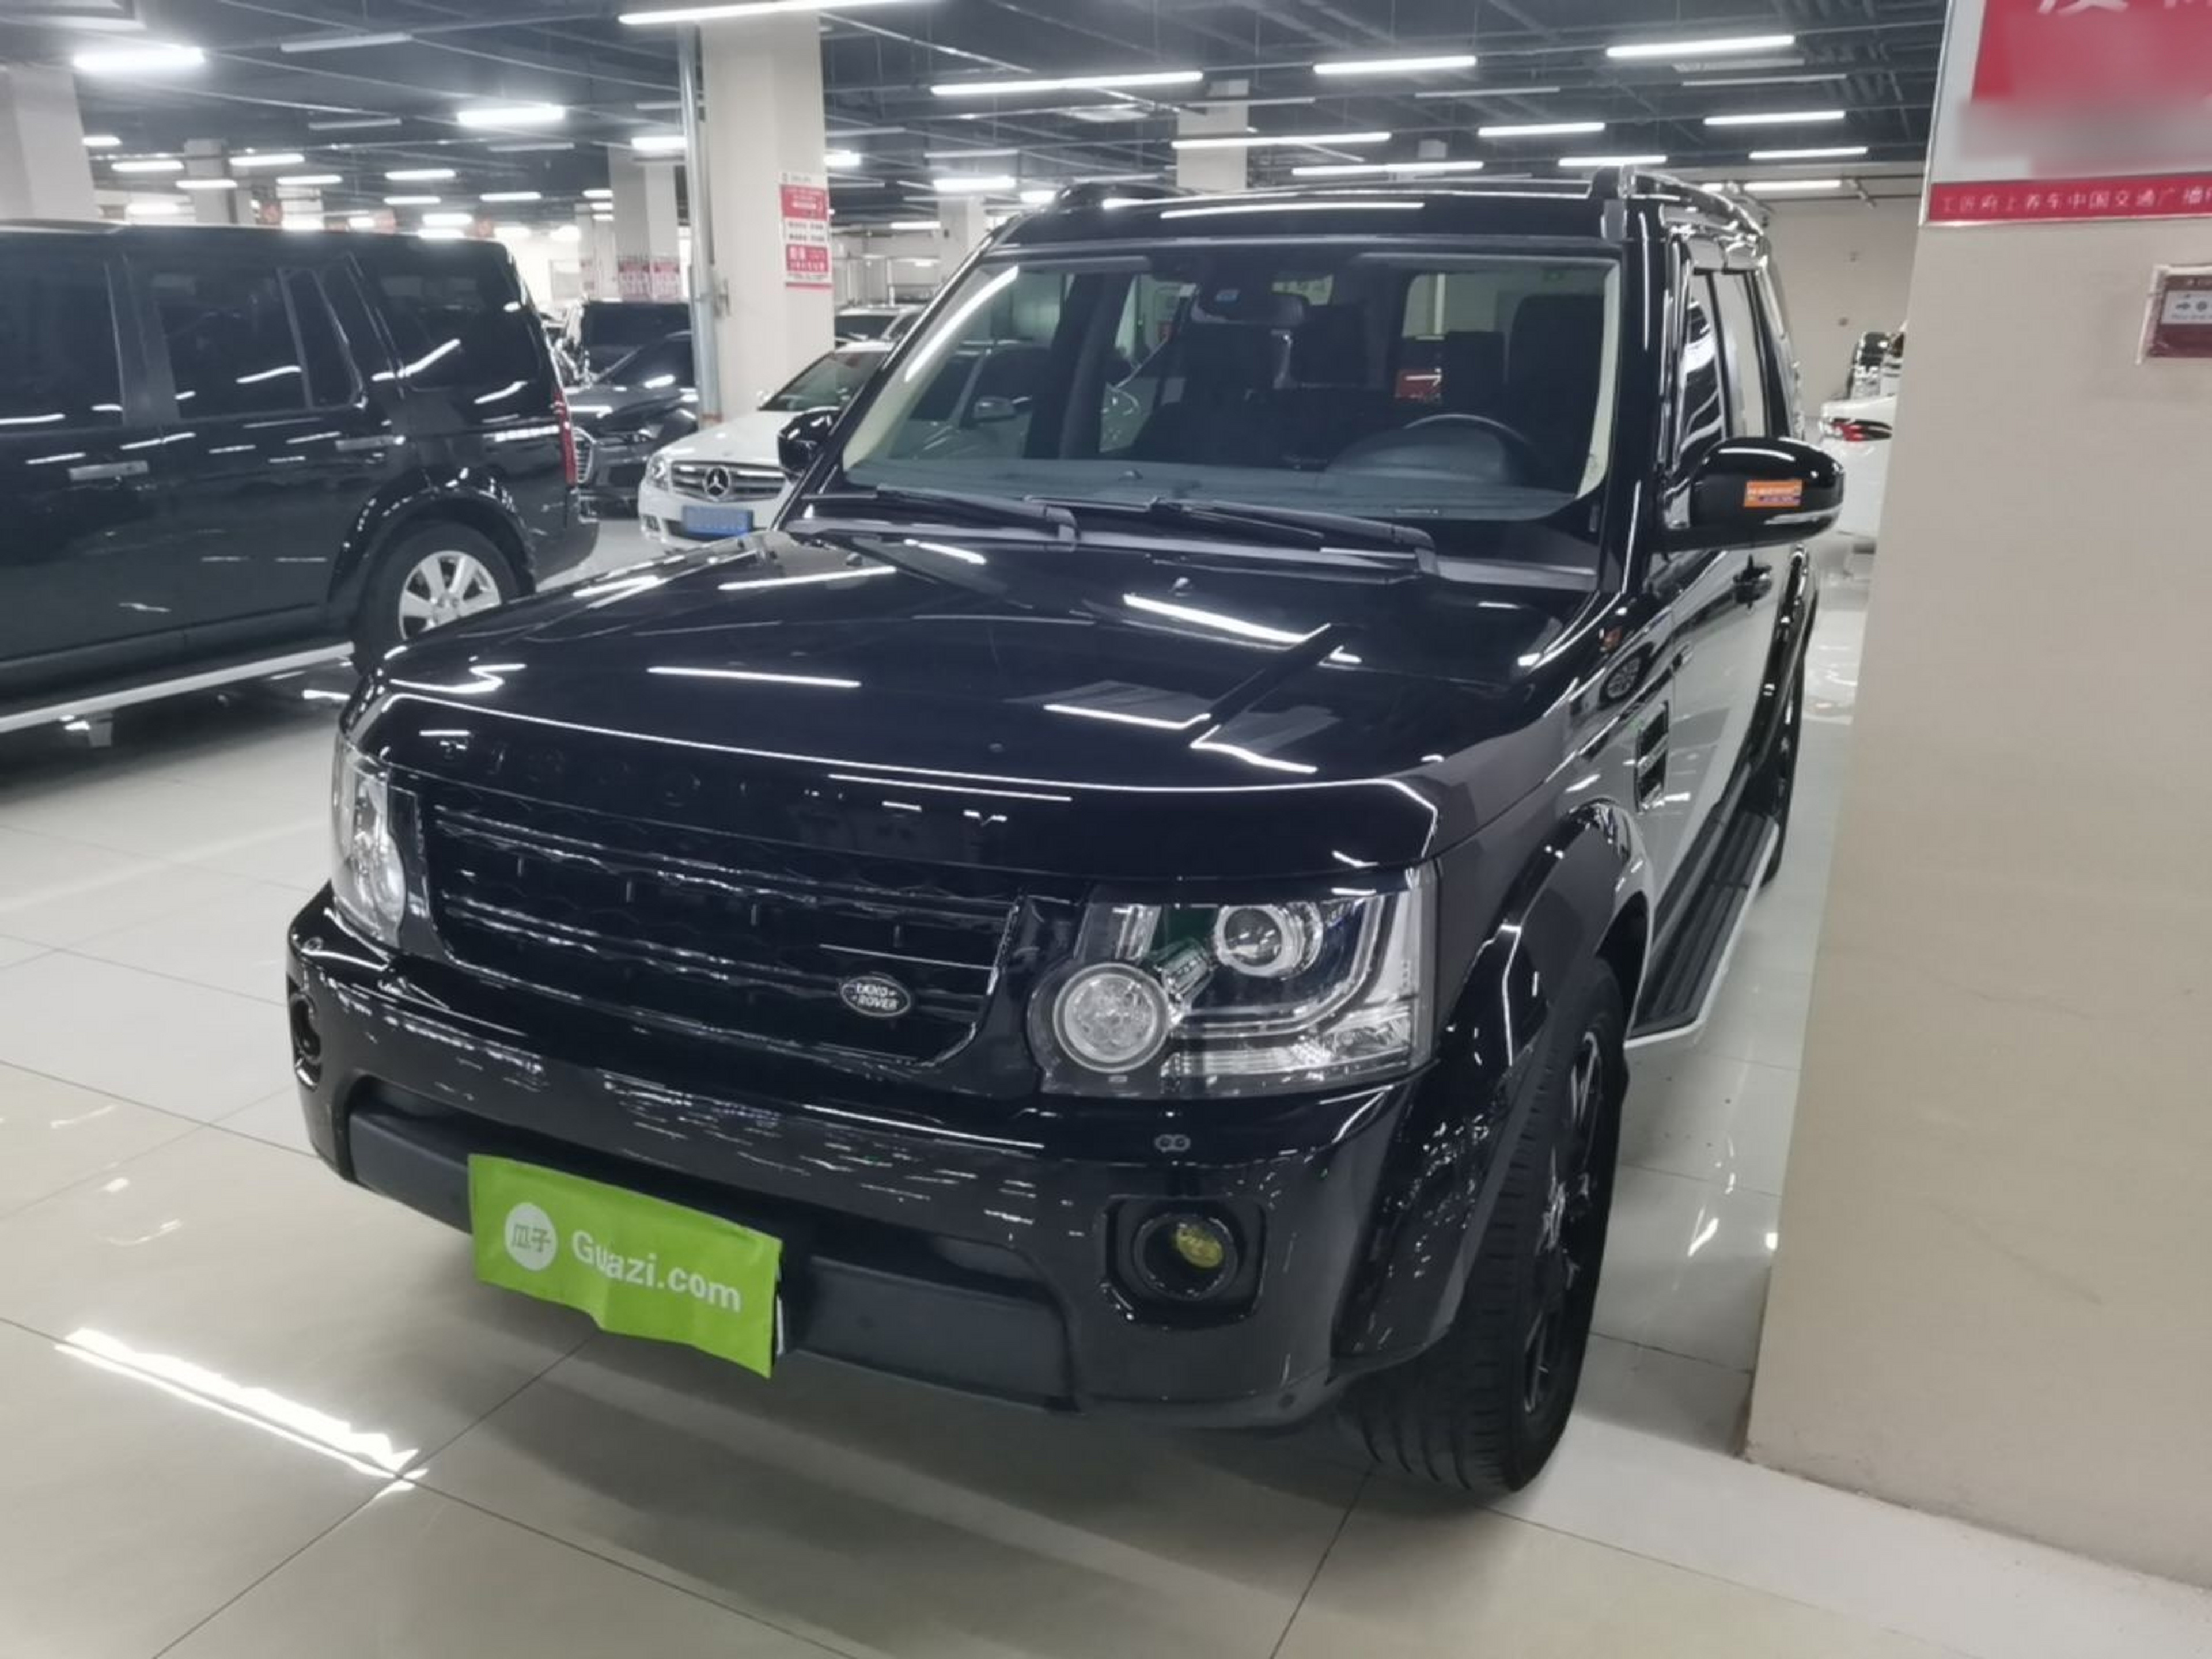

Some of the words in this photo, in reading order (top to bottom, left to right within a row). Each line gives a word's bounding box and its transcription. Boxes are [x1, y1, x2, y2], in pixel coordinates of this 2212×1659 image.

[856, 983, 889, 997] LAND
[510, 1222, 551, 1253] 瓜子
[571, 1229, 741, 1313] Guazi.com
